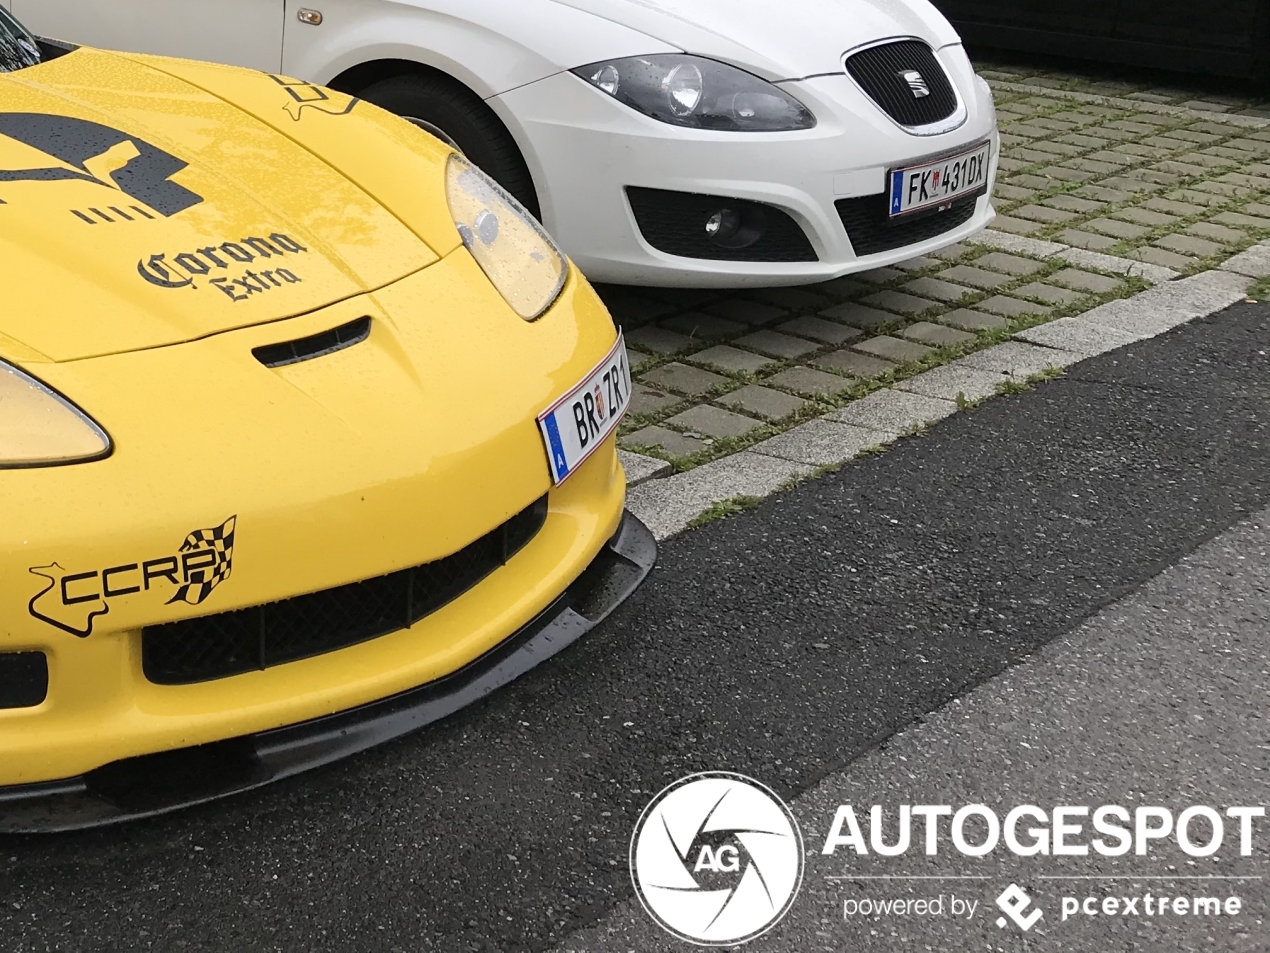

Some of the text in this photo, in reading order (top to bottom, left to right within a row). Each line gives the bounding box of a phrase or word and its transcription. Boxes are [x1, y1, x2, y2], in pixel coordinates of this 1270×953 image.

[893, 197, 899, 207] A
[908, 152, 984, 205] FK 431DX
[137, 232, 308, 290] Corona
[209, 267, 302, 302] Extra
[572, 353, 629, 449] BR ZR1
[557, 453, 564, 469] A
[60, 548, 216, 605] CCRP
